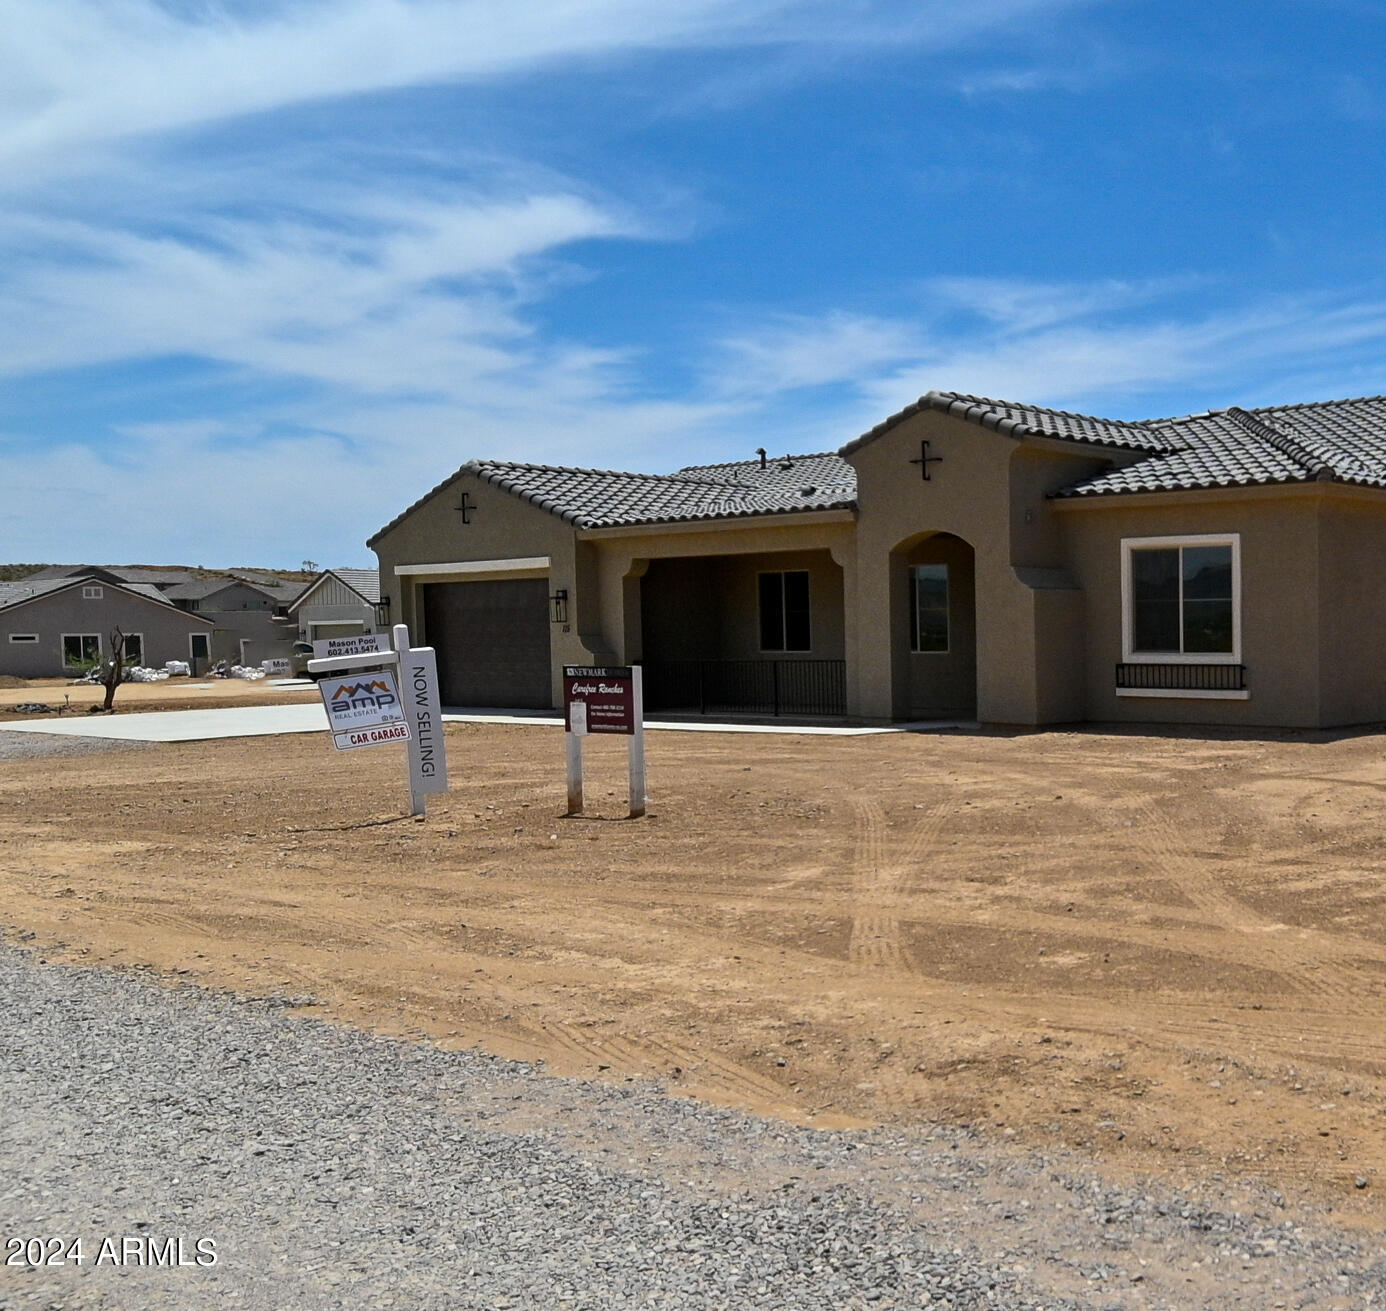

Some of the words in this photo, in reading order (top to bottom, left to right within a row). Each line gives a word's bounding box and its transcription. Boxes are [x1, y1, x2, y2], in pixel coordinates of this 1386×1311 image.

[328, 640, 357, 649] Mason
[358, 636, 377, 646] Pool
[574, 667, 607, 677] NEWMARK
[412, 666, 429, 707] NOW
[330, 693, 396, 713] amp
[334, 712, 353, 721] REAL
[353, 708, 378, 718] ESTATE
[350, 732, 370, 745] CAR
[370, 726, 407, 742] GARAGE
[416, 711, 436, 778] SELLING!
